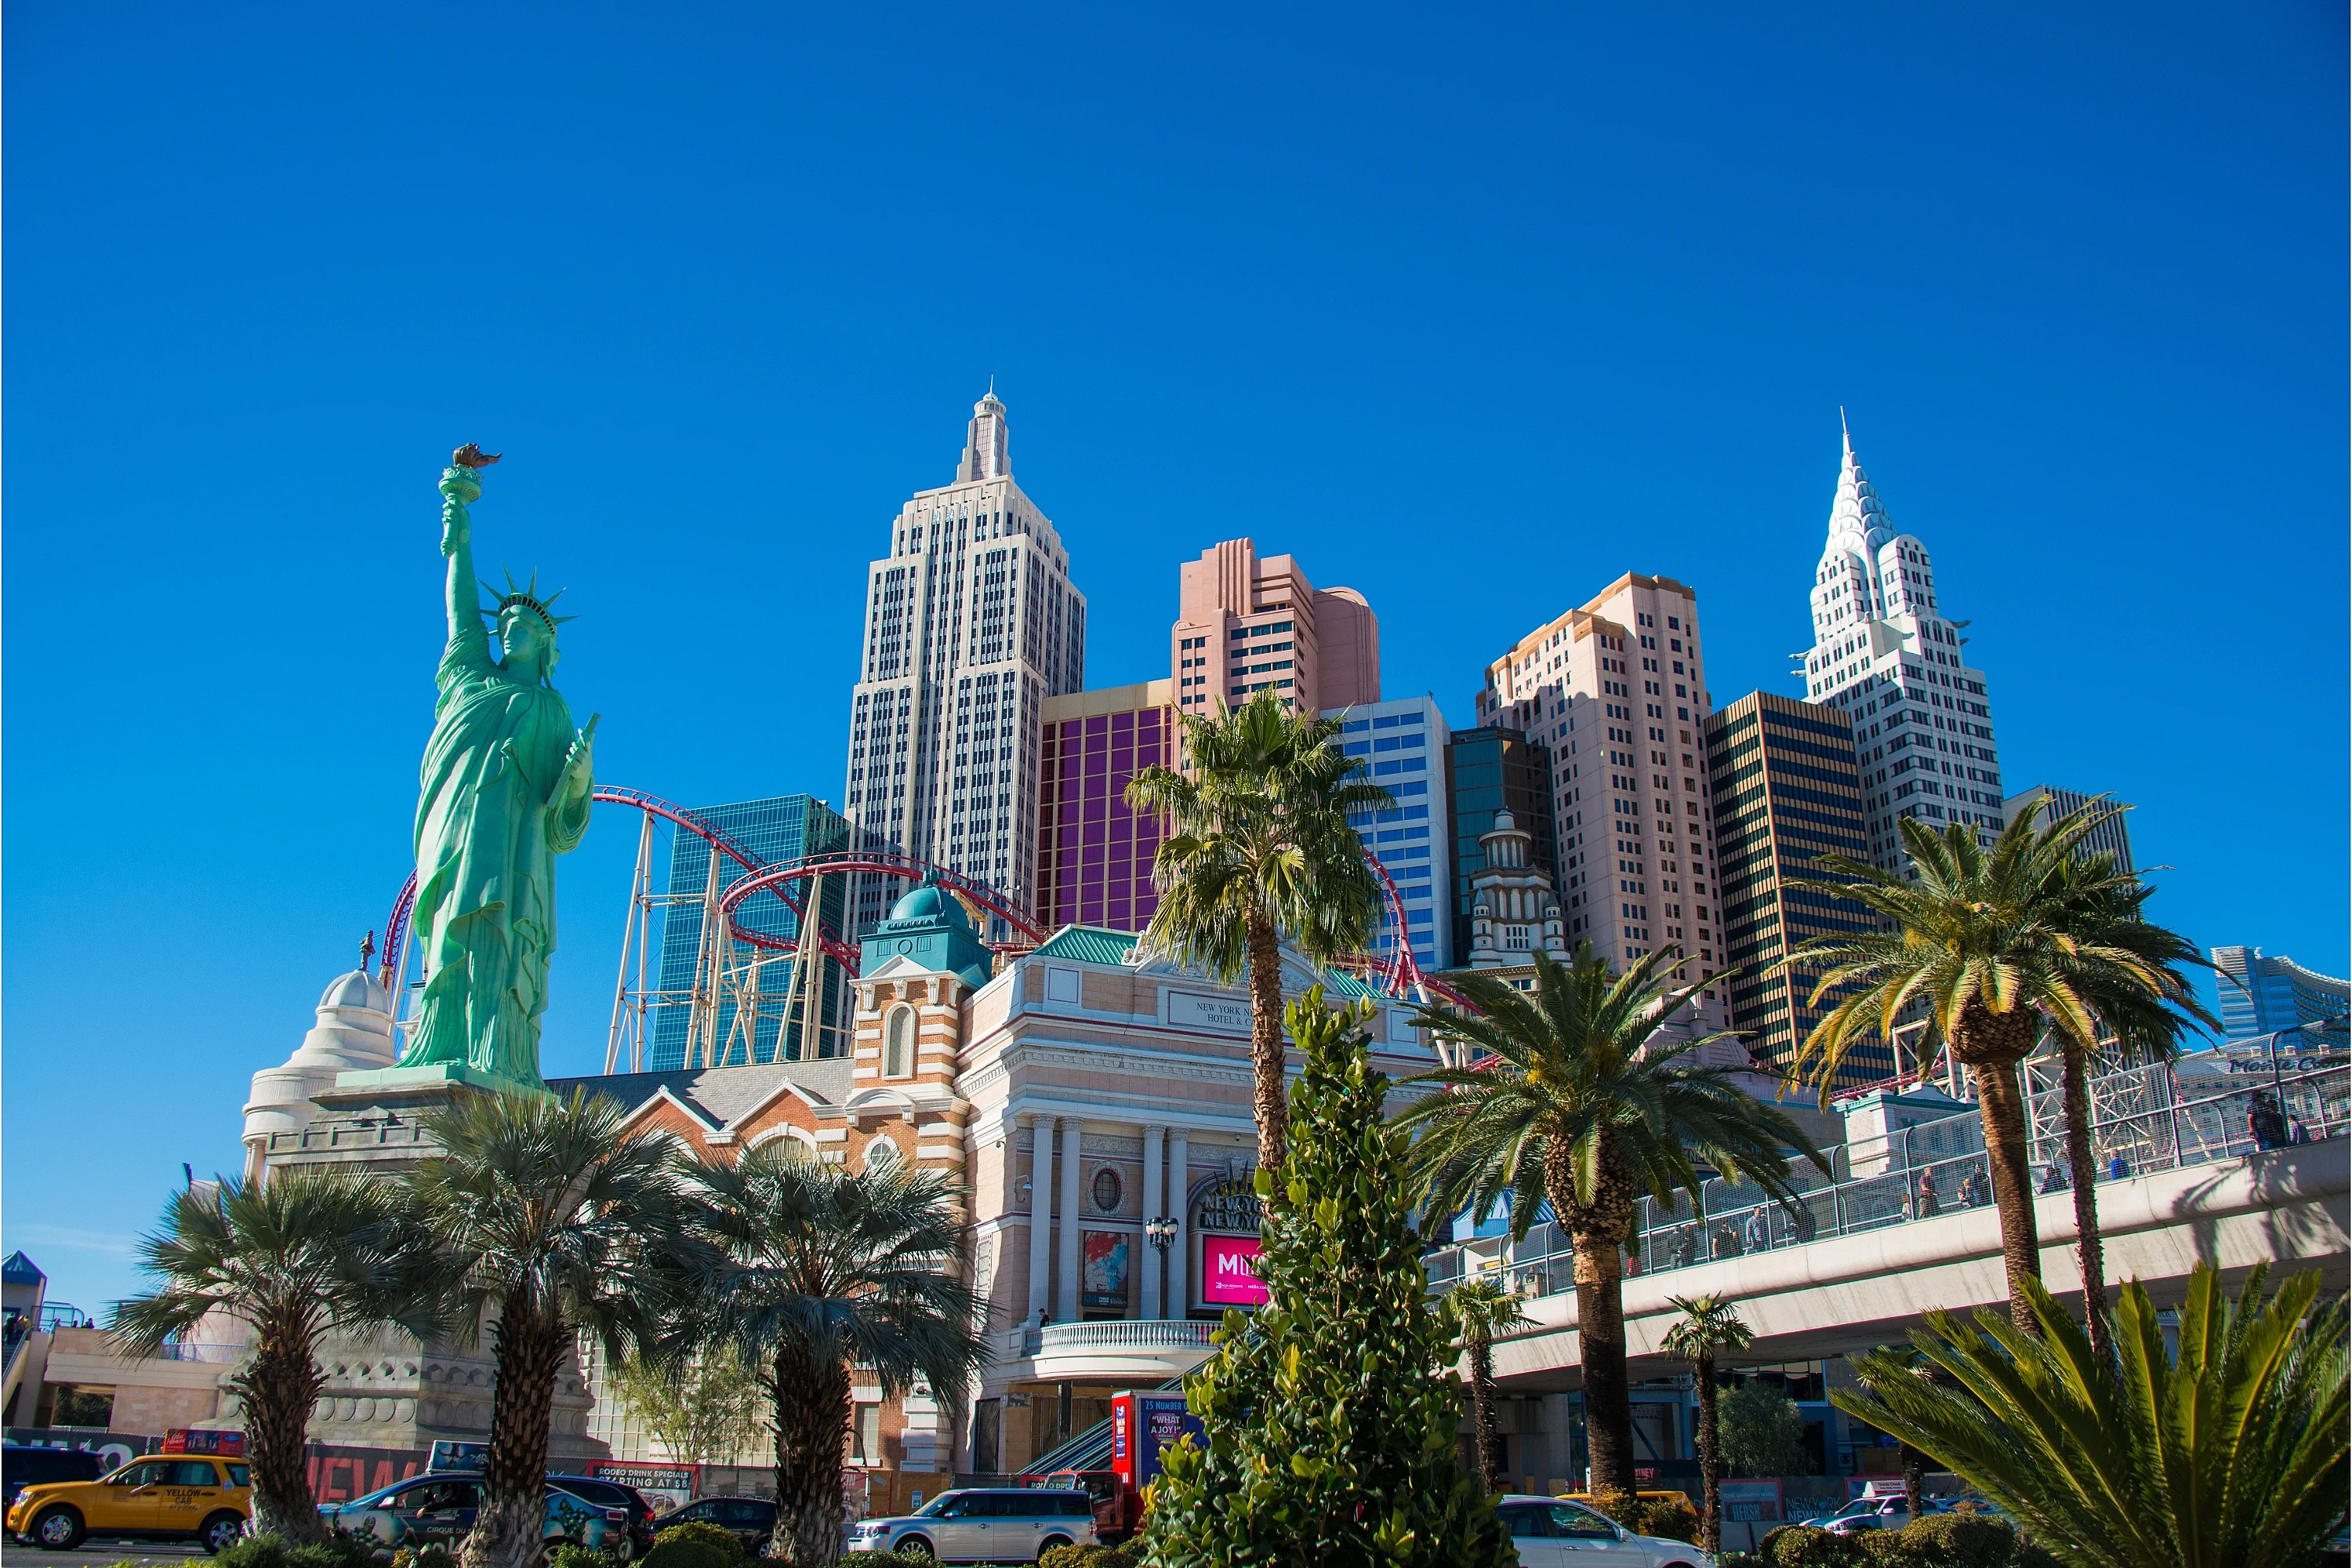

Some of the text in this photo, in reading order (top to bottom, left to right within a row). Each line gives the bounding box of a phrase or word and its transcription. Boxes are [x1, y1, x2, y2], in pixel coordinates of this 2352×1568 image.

[1196, 1003, 1216, 1011] NEW
[1218, 1005, 1240, 1015] YORK
[1207, 1014, 1234, 1024] HOTEL
[2229, 1059, 2296, 1073] Mone
[1205, 1194, 1240, 1210] NEW
[1205, 1212, 1240, 1228] NEW
[1145, 1400, 1153, 1410] 25
[1156, 1401, 1181, 1410] NUMBER
[654, 1470, 689, 1479] SPECIALS
[658, 1479, 671, 1487] AT
[675, 1479, 688, 1488] $8
[426, 1526, 454, 1535] CIRQUE
